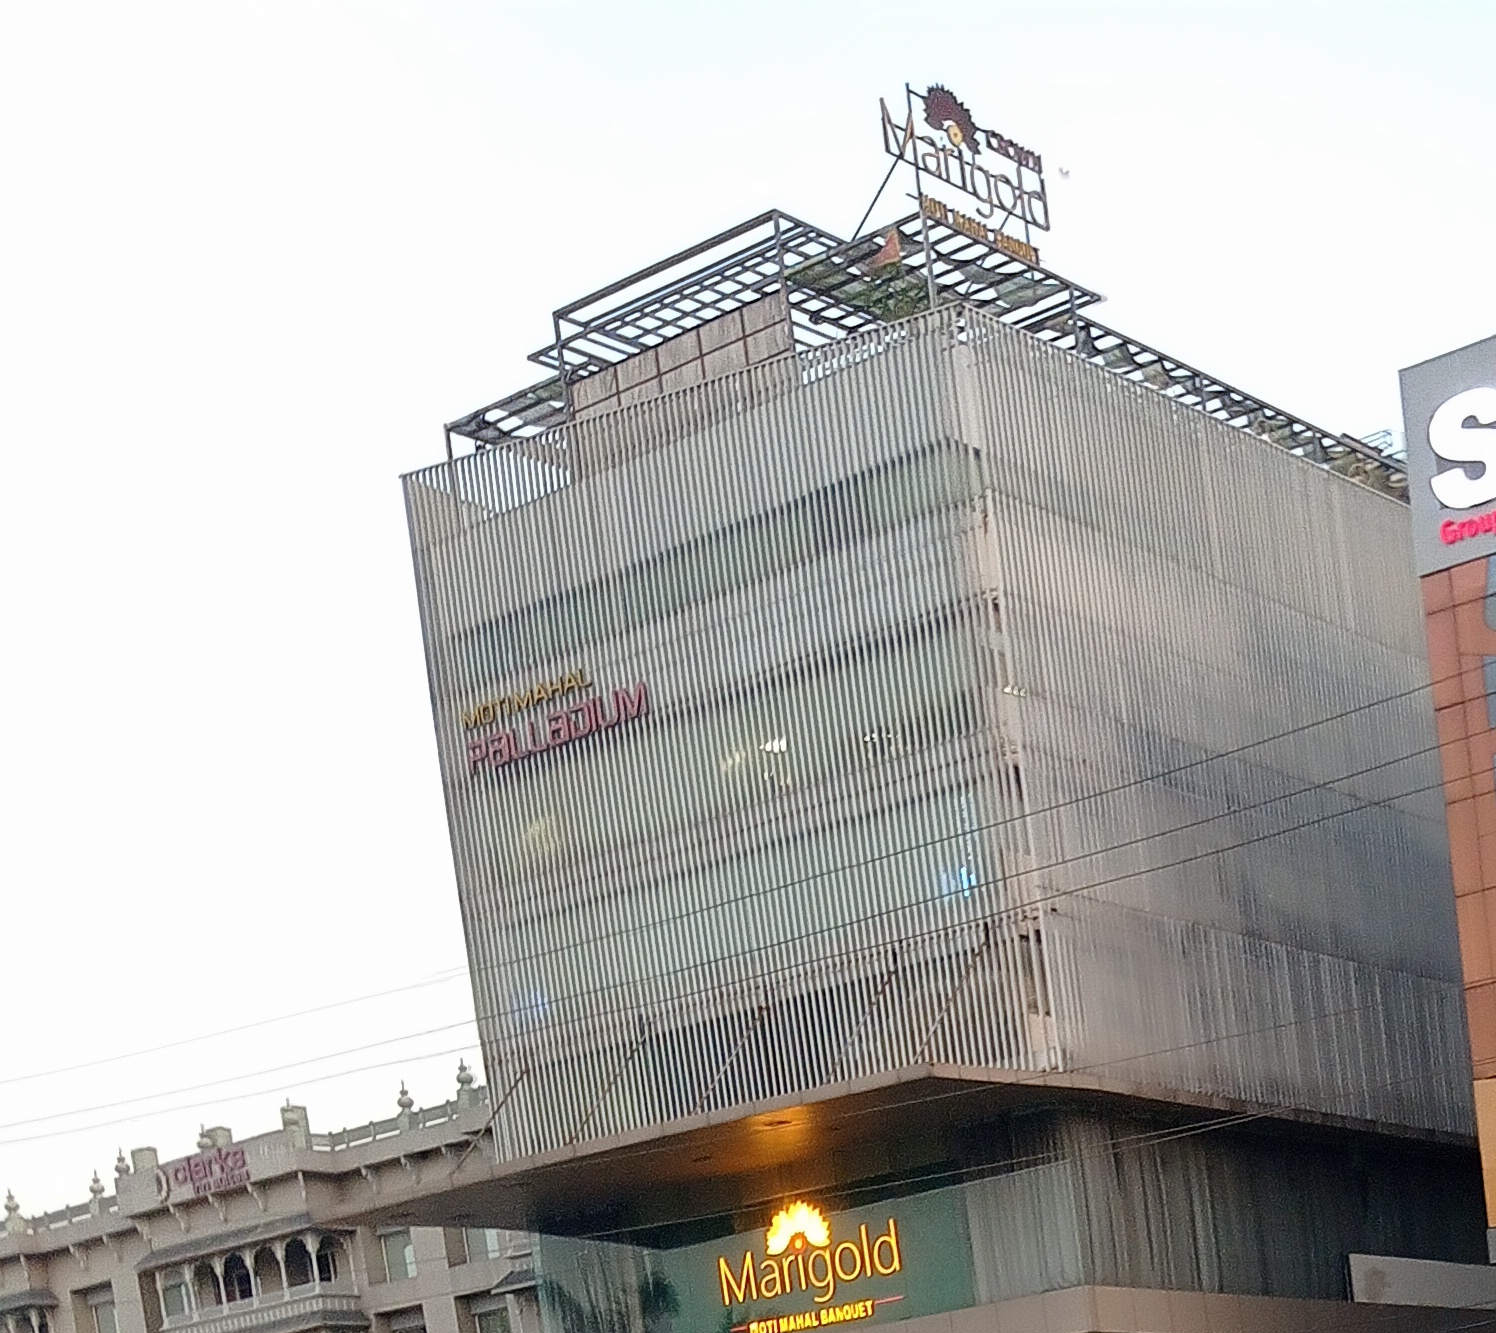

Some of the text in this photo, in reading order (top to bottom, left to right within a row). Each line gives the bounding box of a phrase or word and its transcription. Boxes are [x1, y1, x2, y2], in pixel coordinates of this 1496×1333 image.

[879, 97, 1050, 232] Marigold
[462, 668, 593, 730] MOTI MAHAL
[717, 1217, 902, 1306] Marigold
[778, 1311, 820, 1333] MAHAL
[820, 1300, 874, 1326] BANQUET
